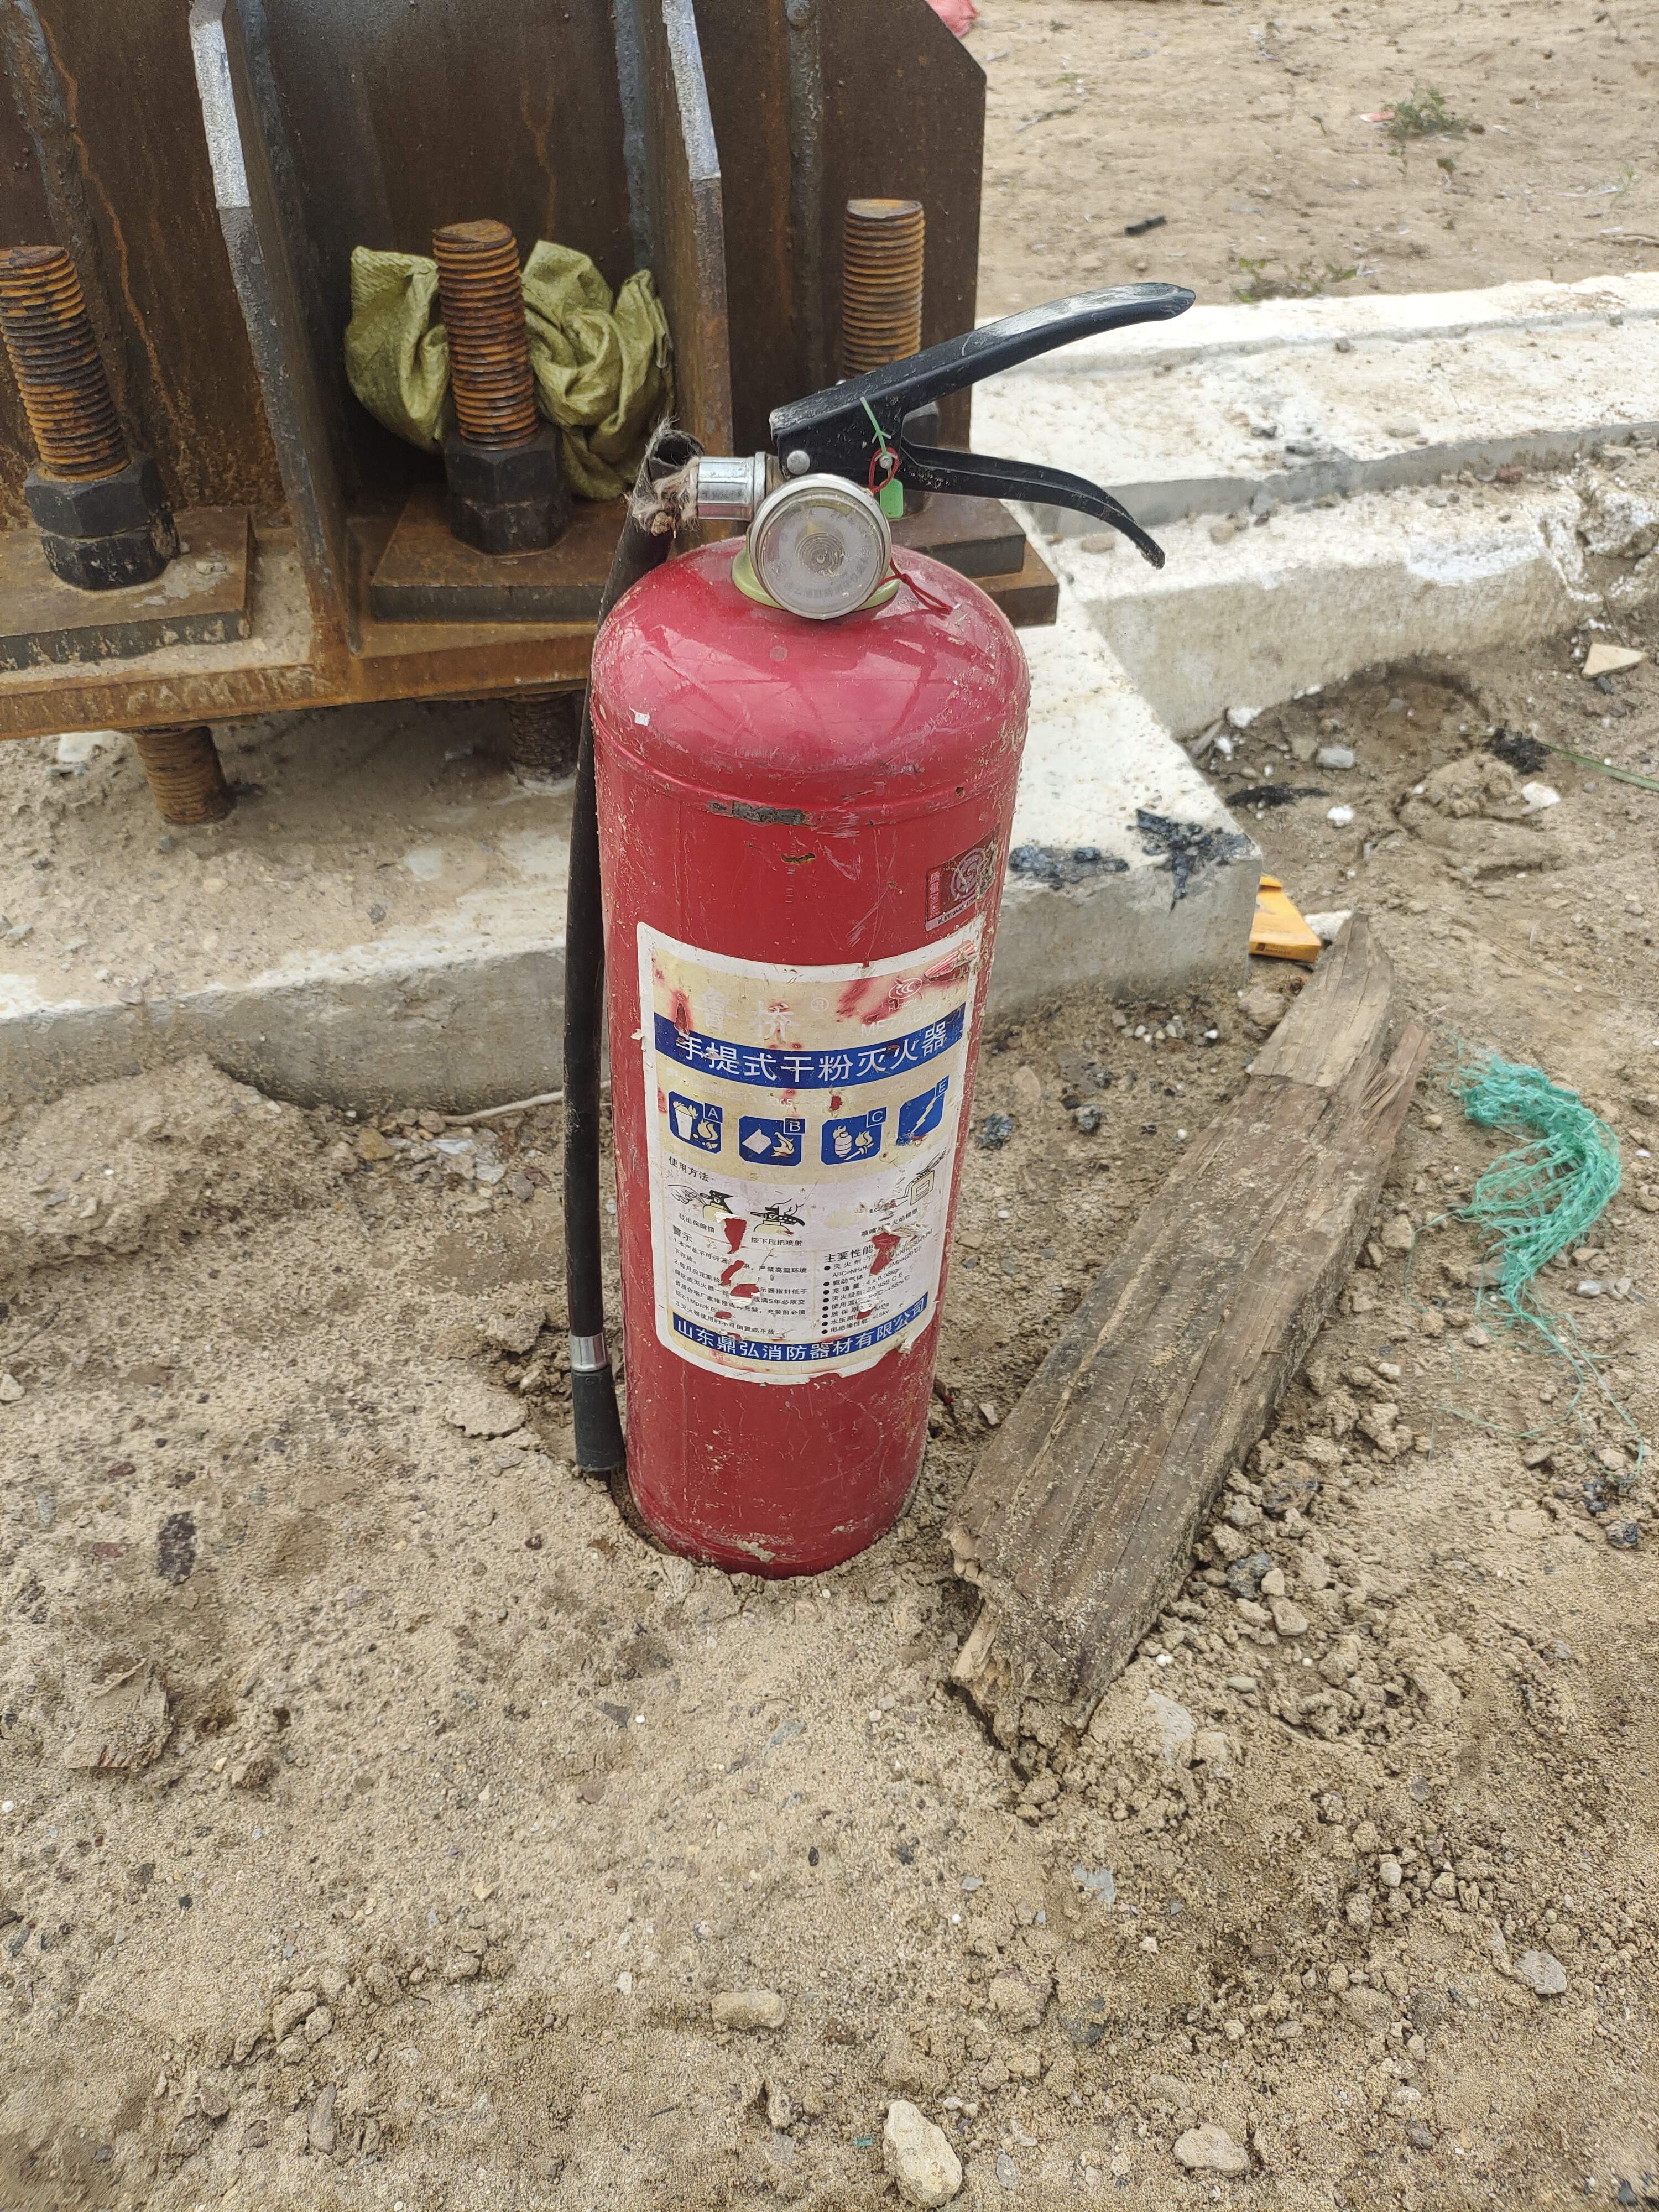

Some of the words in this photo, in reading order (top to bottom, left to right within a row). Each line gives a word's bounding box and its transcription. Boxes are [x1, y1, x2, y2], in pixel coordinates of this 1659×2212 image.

[676, 1021, 947, 1083] 手提式干粉灭火器
[707, 1108, 719, 1120] A
[789, 1120, 801, 1132] B
[872, 1110, 884, 1123] C
[938, 1079, 947, 1093] E
[669, 1156, 709, 1182] 使用方法
[672, 1225, 693, 1243] 警示
[750, 1237, 802, 1247] 按下压把喷射
[824, 1244, 874, 1263] 主要性能
[678, 1298, 925, 1361] 山东鼎弘消防器材有限公司
